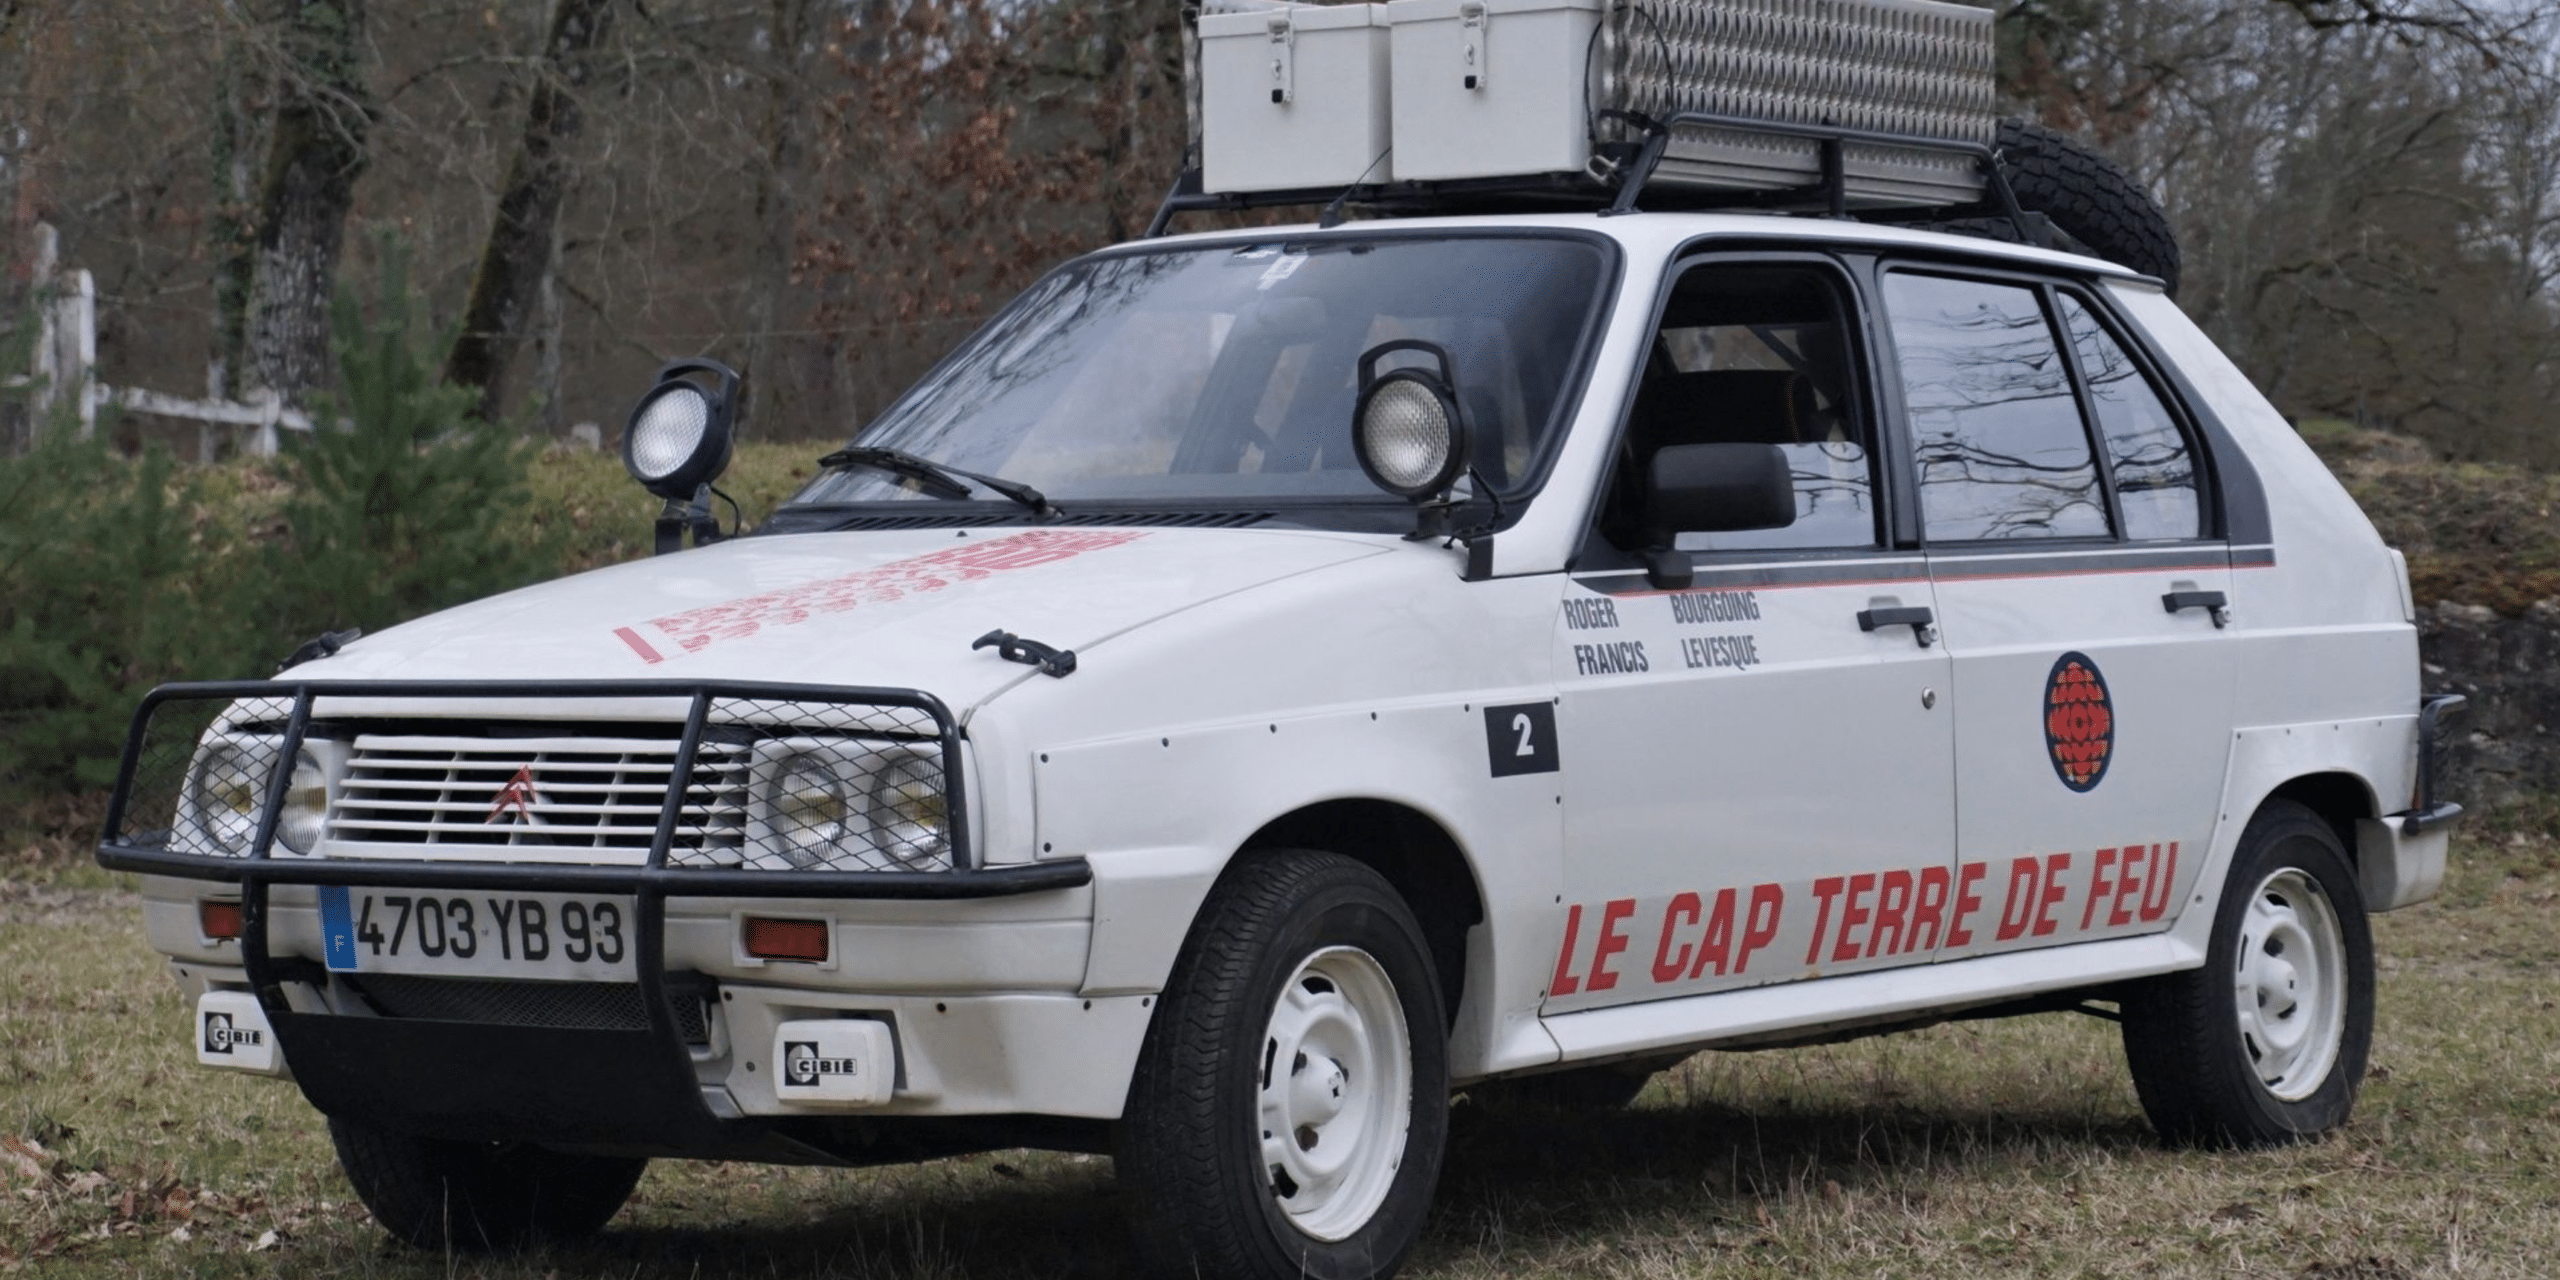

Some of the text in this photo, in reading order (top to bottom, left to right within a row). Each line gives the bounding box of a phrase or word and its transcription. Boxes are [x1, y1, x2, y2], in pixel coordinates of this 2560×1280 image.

[1562, 591, 1761, 630] ROGER BOURGOING
[1573, 634, 1761, 676] FRANCIS LEVESQUE
[1512, 712, 1535, 757] 2
[357, 895, 626, 964] 4703 YB 93
[1549, 841, 2180, 997] LE CAP TERRE DE FEU
[334, 934, 346, 952] F
